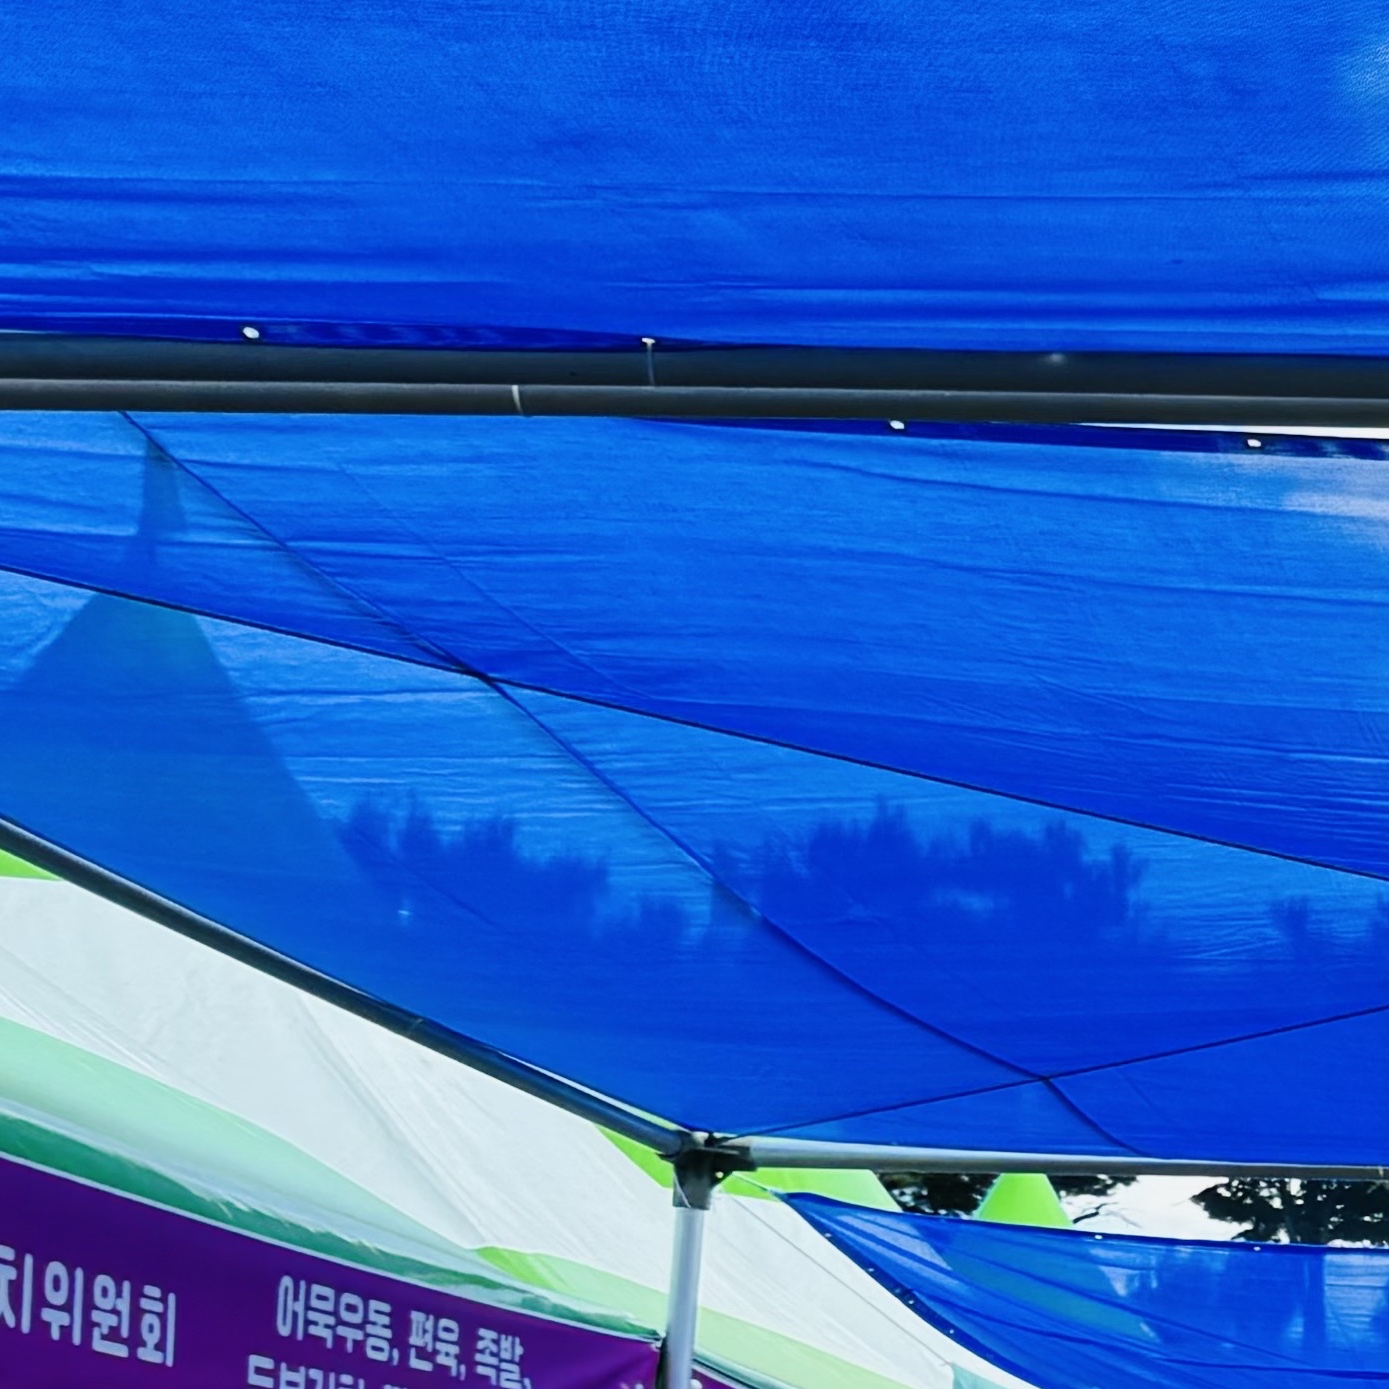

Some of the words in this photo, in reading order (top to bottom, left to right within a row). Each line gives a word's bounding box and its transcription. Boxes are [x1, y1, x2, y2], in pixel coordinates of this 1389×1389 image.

[0, 1244, 176, 1367] 치위원회
[277, 1275, 399, 1366] 어묵우동,
[409, 1310, 466, 1381] 편육,
